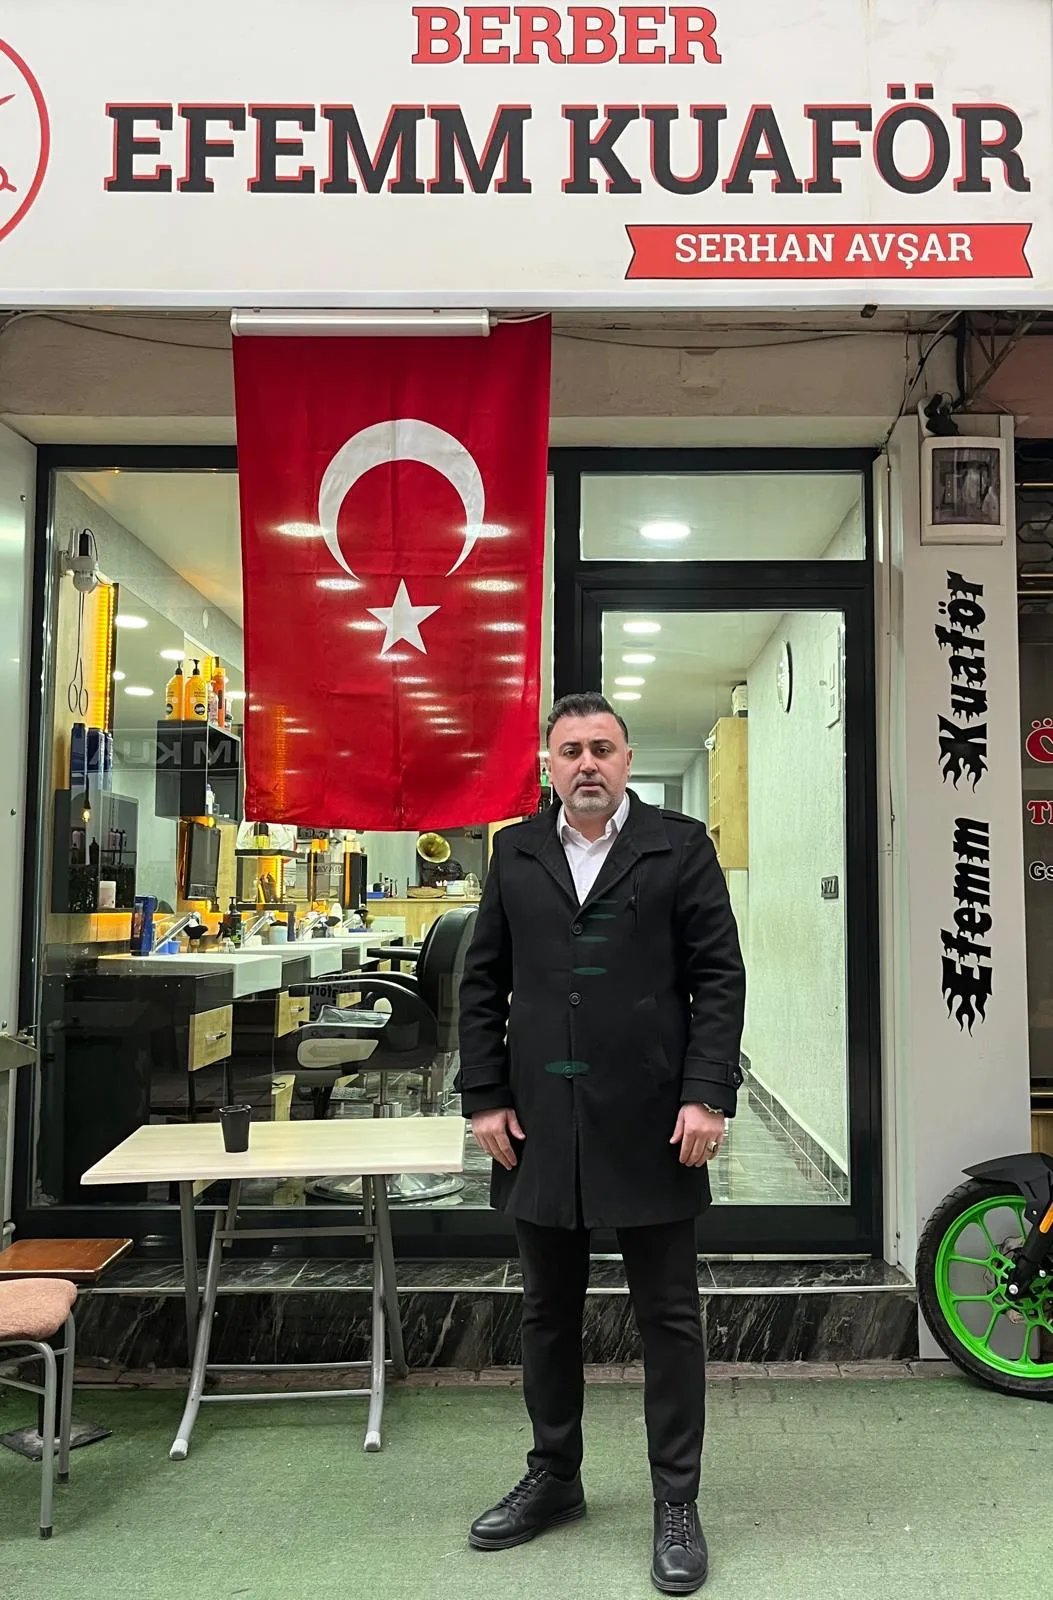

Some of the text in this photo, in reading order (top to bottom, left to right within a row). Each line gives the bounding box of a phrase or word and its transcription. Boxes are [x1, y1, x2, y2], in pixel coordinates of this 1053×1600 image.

[412, 6, 722, 64] BERBER
[104, 83, 1031, 194] EFEMM KUAFÖR
[674, 232, 974, 269] SERHAN AVŞAR
[935, 569, 993, 1038] Efemm Kuaför
